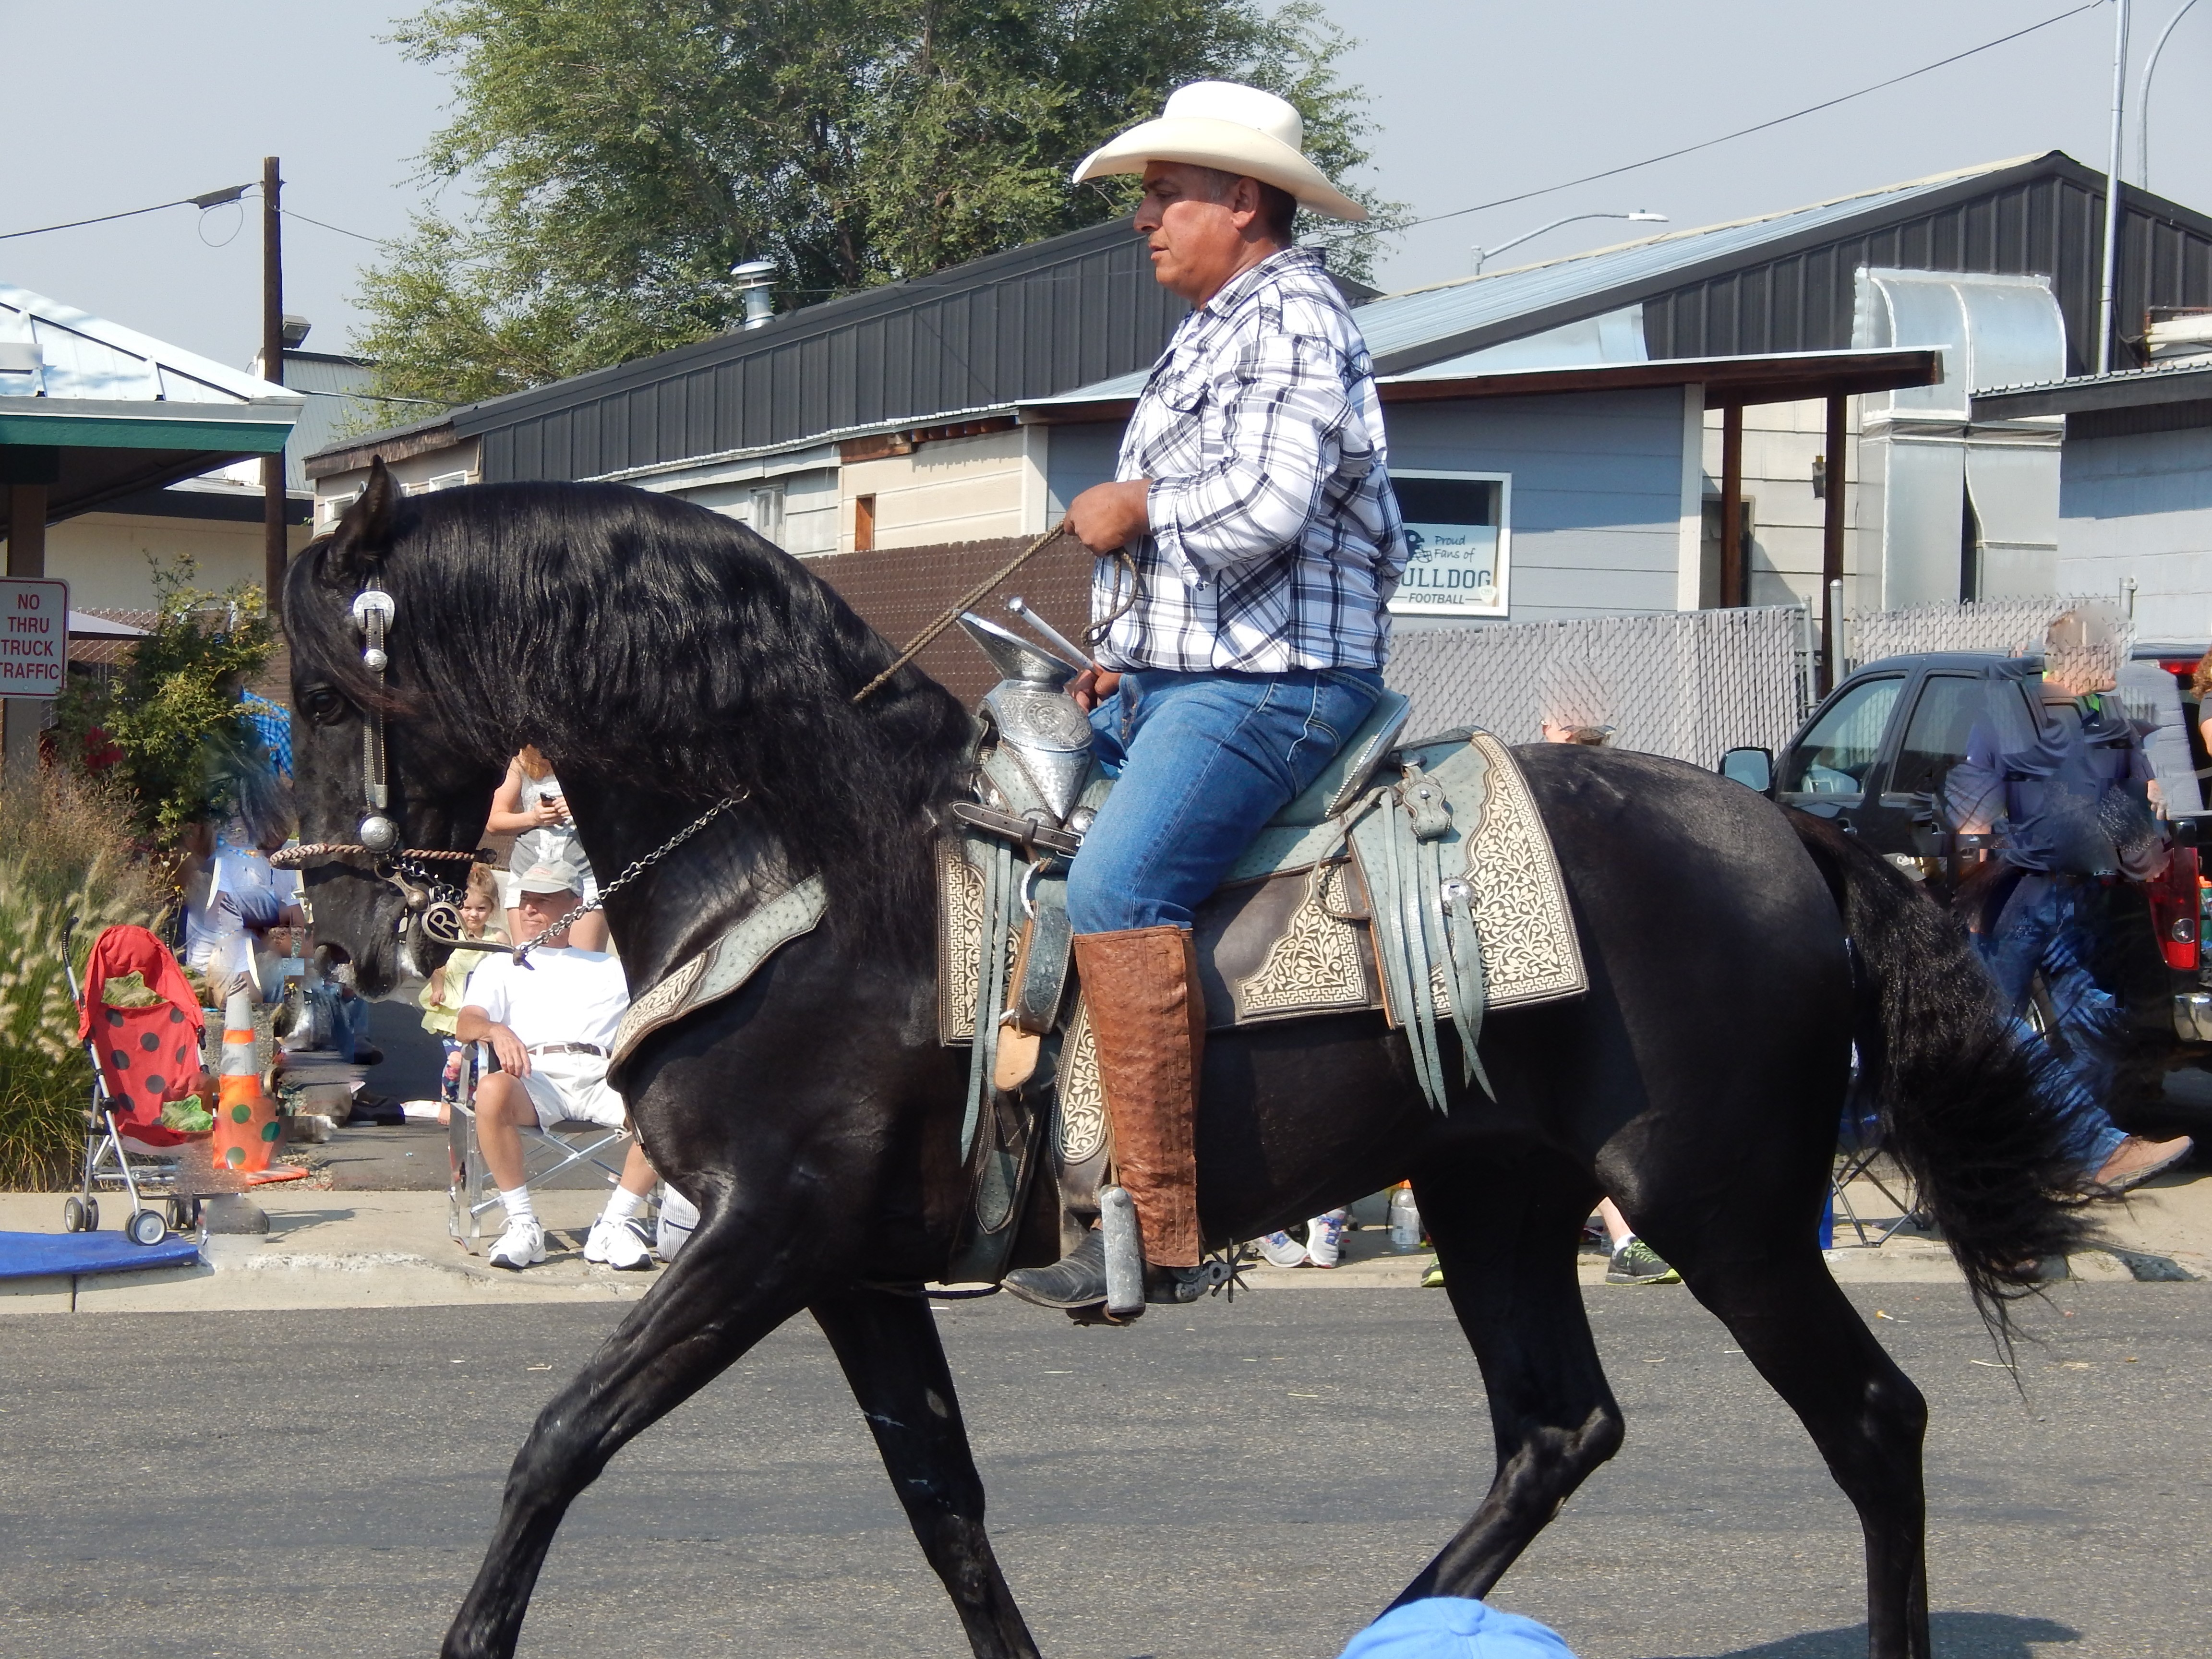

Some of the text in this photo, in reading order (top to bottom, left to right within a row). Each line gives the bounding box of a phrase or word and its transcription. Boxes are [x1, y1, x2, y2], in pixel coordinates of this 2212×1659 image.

[1435, 535, 1466, 545] Proud
[1434, 548, 1476, 563] Fans of
[1401, 568, 1491, 589] ULLDOG
[18, 594, 40, 610] NO
[1408, 593, 1465, 604] FOOTBALL
[8, 616, 49, 634] THRU
[1, 639, 54, 656] TRUCK
